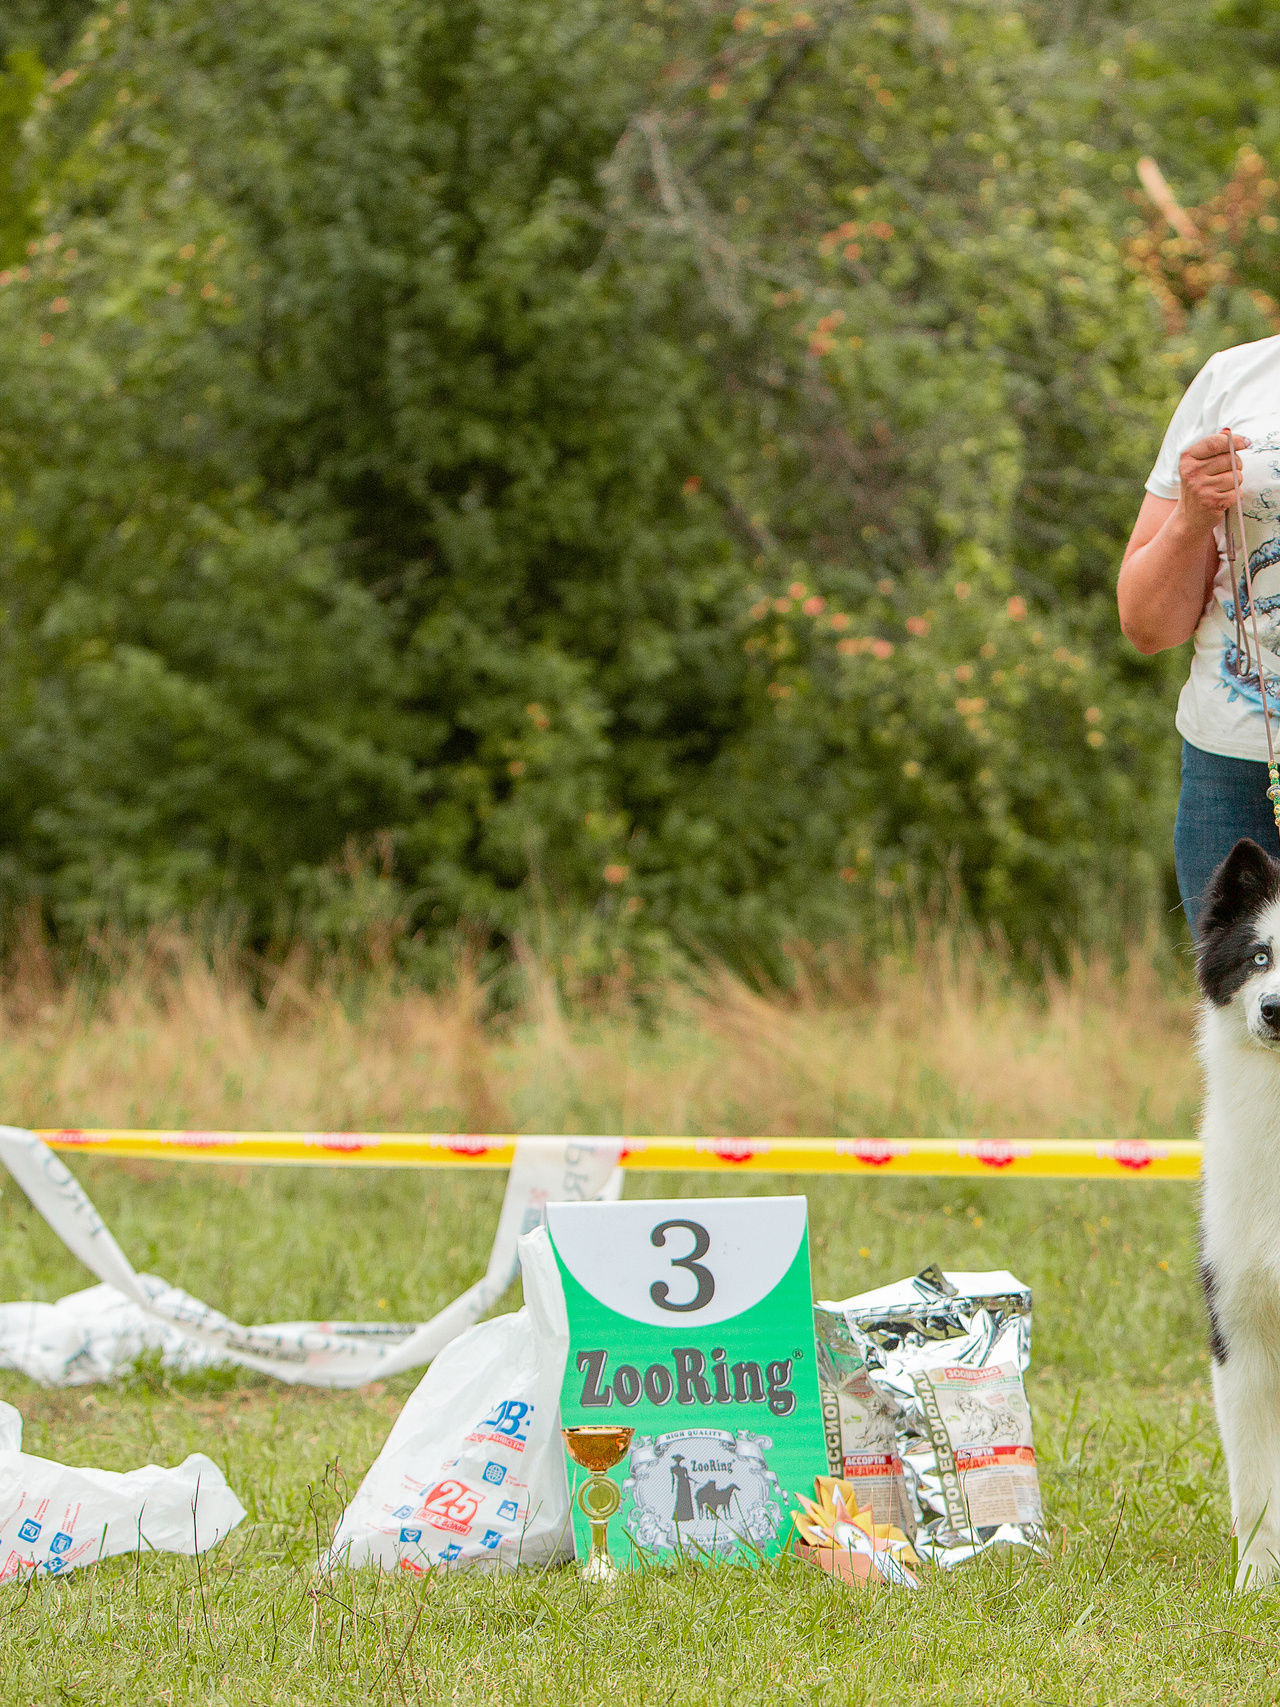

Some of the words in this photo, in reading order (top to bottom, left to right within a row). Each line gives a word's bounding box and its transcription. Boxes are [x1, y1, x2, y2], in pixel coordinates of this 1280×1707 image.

[649, 1218, 716, 1313] 3
[576, 1347, 798, 1417] ZooRing
[665, 1431, 685, 1440] HIGH
[687, 1430, 723, 1438] QUALITY
[690, 1459, 733, 1474] ZooRing
[845, 1455, 886, 1466] АССОРТИ
[845, 1466, 889, 1476] МЕДИУМ
[425, 1480, 486, 1520] 25
